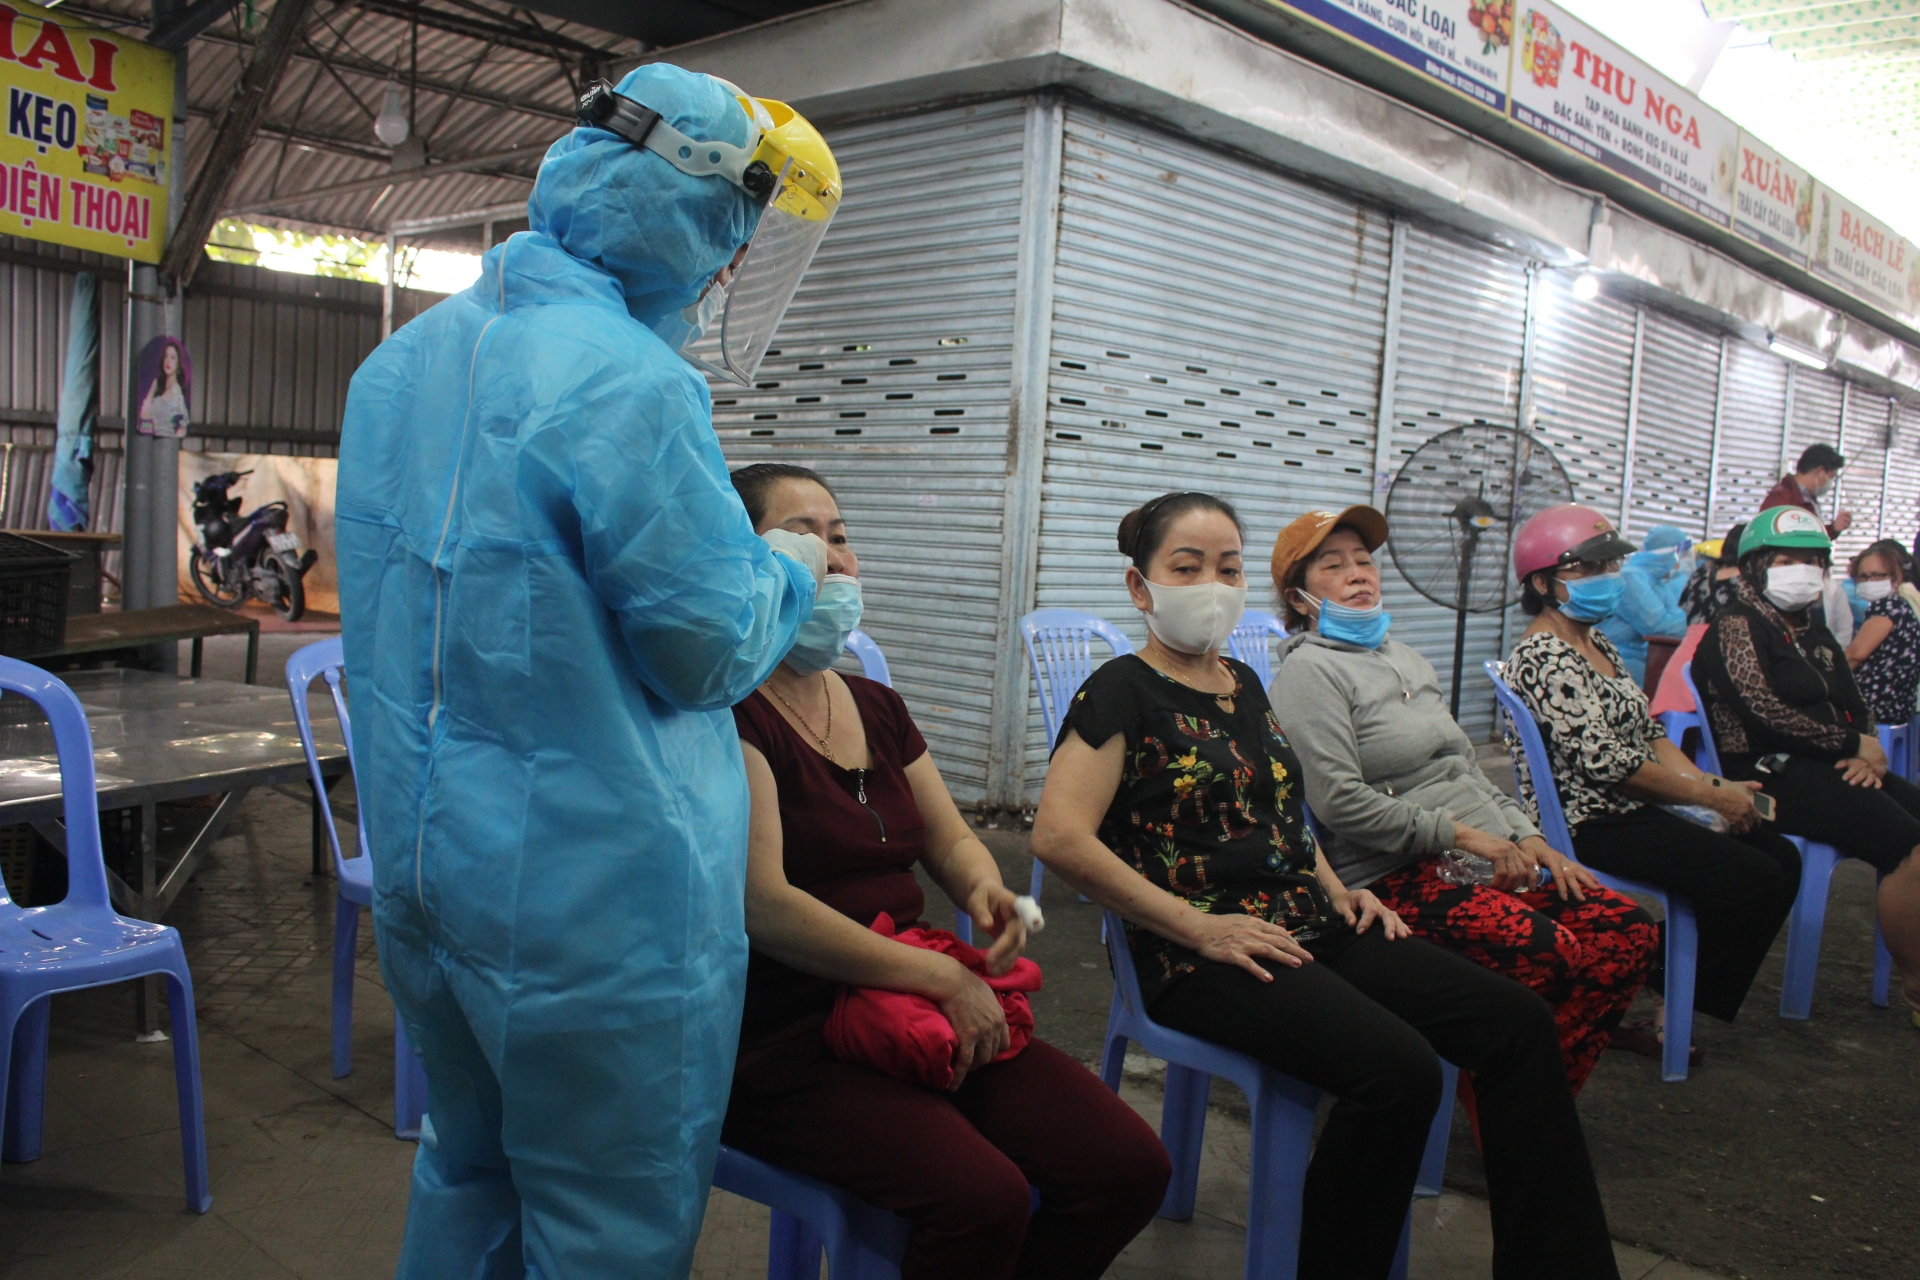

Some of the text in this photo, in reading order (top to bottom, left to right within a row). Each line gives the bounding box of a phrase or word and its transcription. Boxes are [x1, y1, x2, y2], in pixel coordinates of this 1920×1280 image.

[1422, 4, 1456, 41] LOẠI
[9, 87, 77, 154] KẸO
[1570, 40, 1636, 106] THU
[1644, 87, 1702, 149] NGA
[1741, 147, 1798, 209] XUÂN
[70, 180, 151, 248] THOẠI
[1839, 209, 1885, 261] BẠCH
